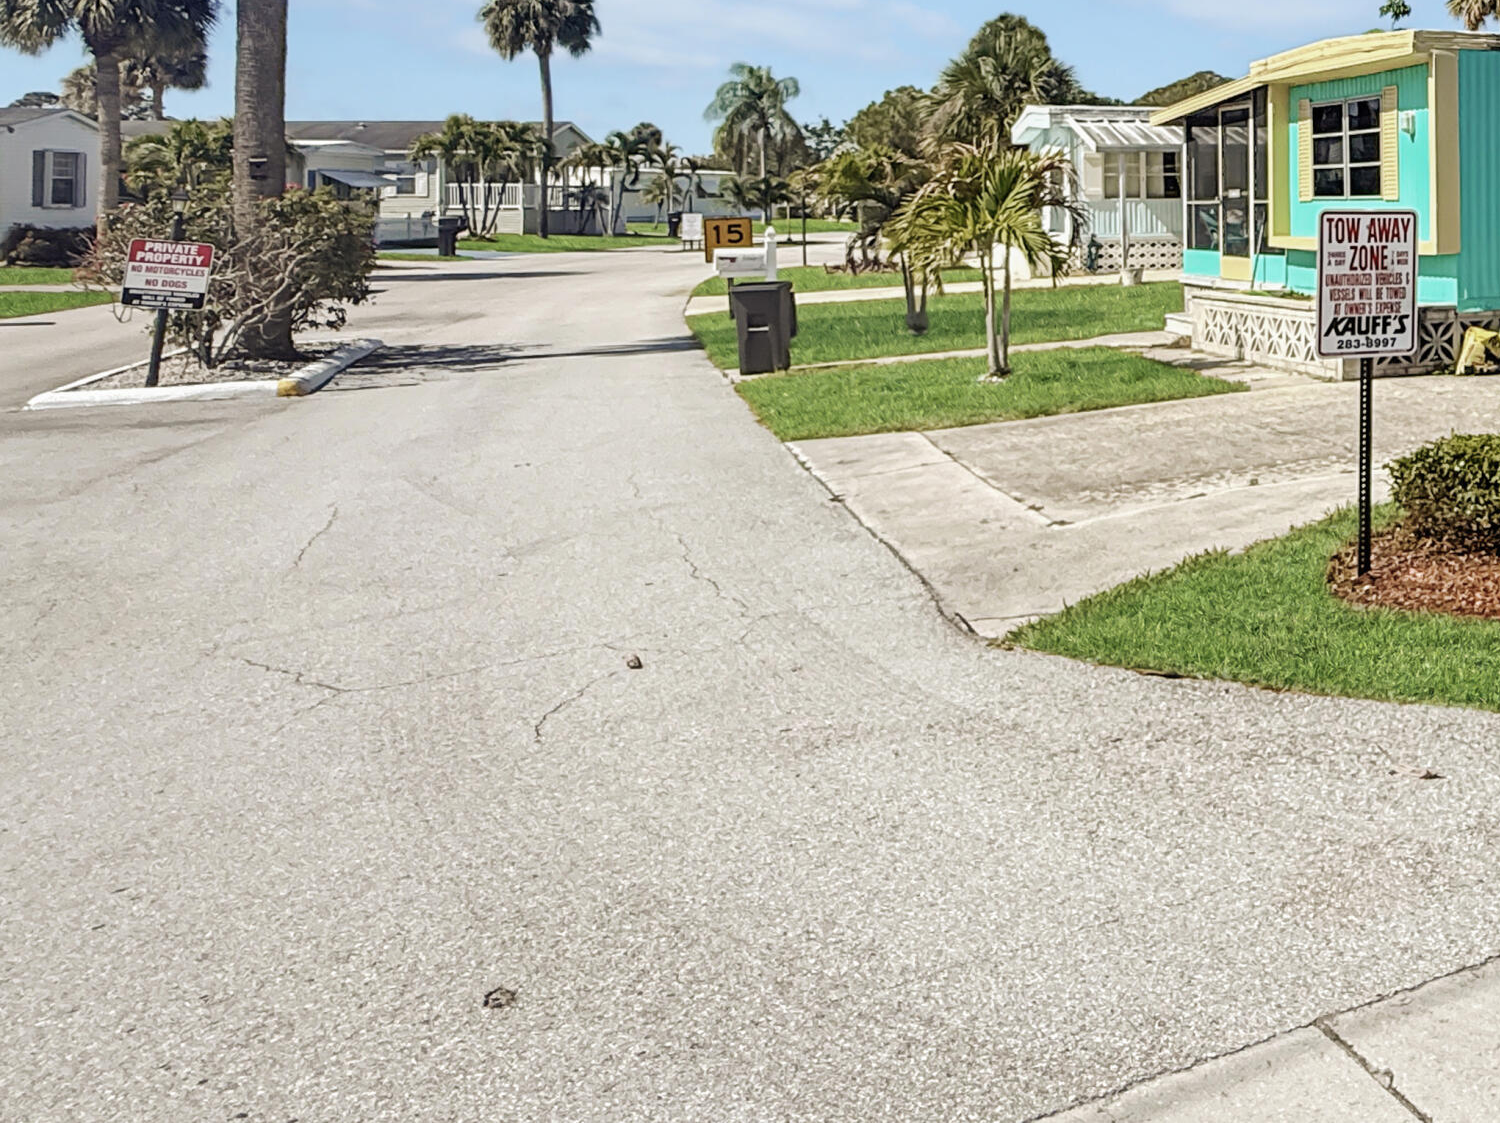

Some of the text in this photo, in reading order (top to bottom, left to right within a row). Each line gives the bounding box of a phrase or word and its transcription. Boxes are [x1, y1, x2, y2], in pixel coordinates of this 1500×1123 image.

[713, 224, 744, 244] 15
[1326, 217, 1411, 244] TOW AWAY
[144, 241, 199, 255] PRIVATE
[135, 251, 205, 266] PROPERTY
[1349, 245, 1388, 271] ZONE
[131, 264, 205, 277] NO MOTORCYCLES
[145, 279, 188, 289] NO DOGS
[1325, 273, 1373, 287] UNAUTHORIZED
[1375, 272, 1403, 286] VEHICLES
[1329, 286, 1407, 301] VESSELS WILL BE TOWED
[1334, 303, 1342, 315] AT
[1375, 301, 1402, 314] EXPENSE
[1324, 314, 1410, 337] KAUFF'S
[1336, 337, 1398, 350] 283-8997
